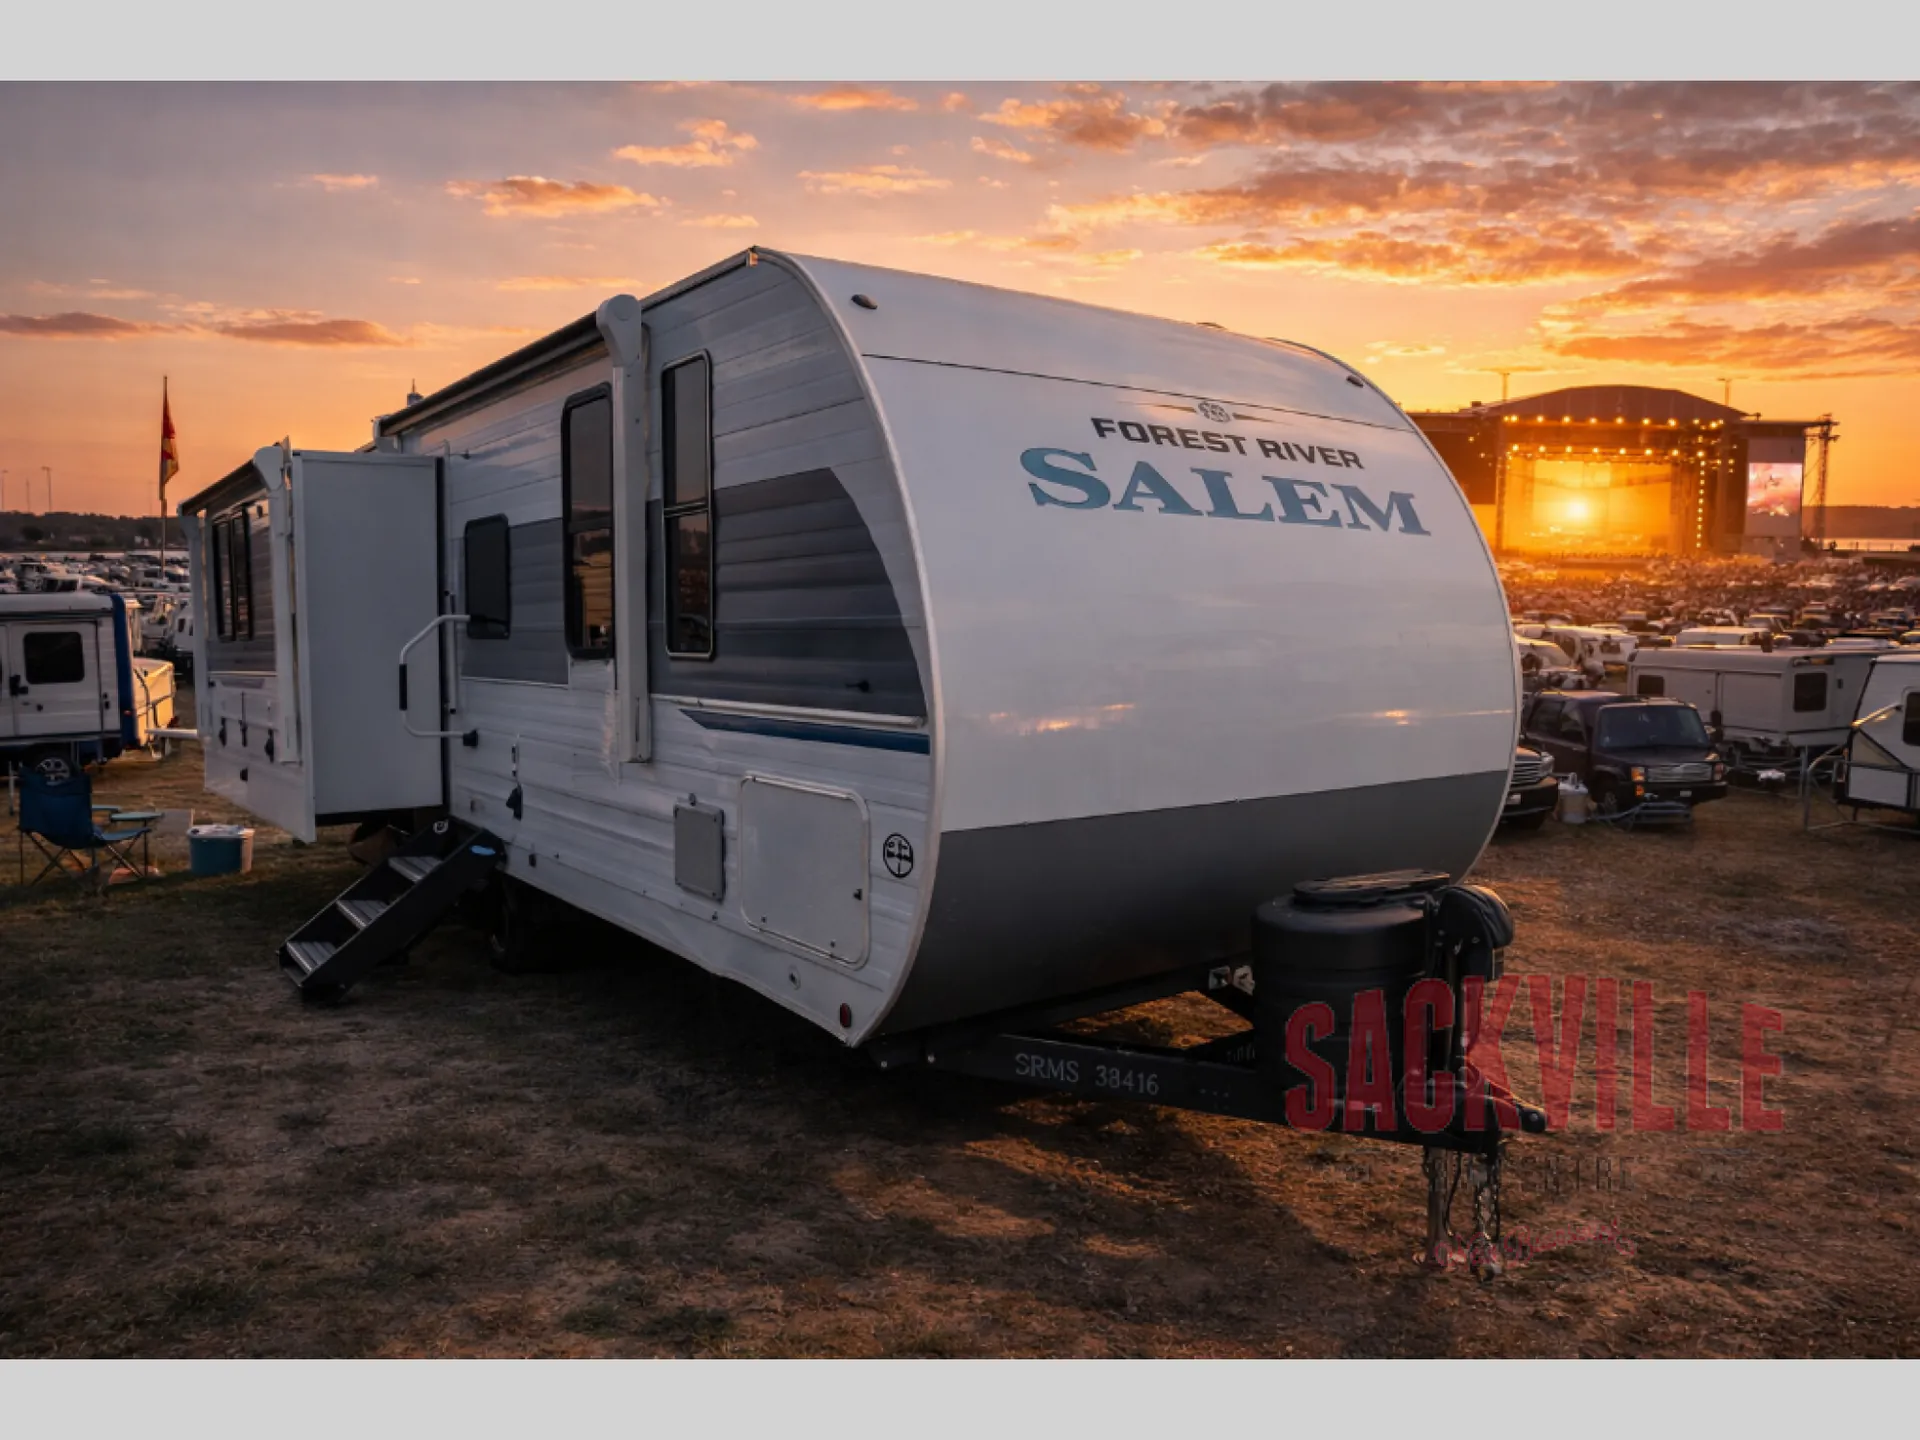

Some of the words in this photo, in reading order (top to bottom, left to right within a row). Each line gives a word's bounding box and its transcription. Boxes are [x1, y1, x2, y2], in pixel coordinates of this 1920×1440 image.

[1090, 417, 1247, 456] FOREST
[1256, 437, 1366, 469] RIVER
[1020, 447, 1431, 536] SALEM
[1014, 1052, 1080, 1083] SRMS
